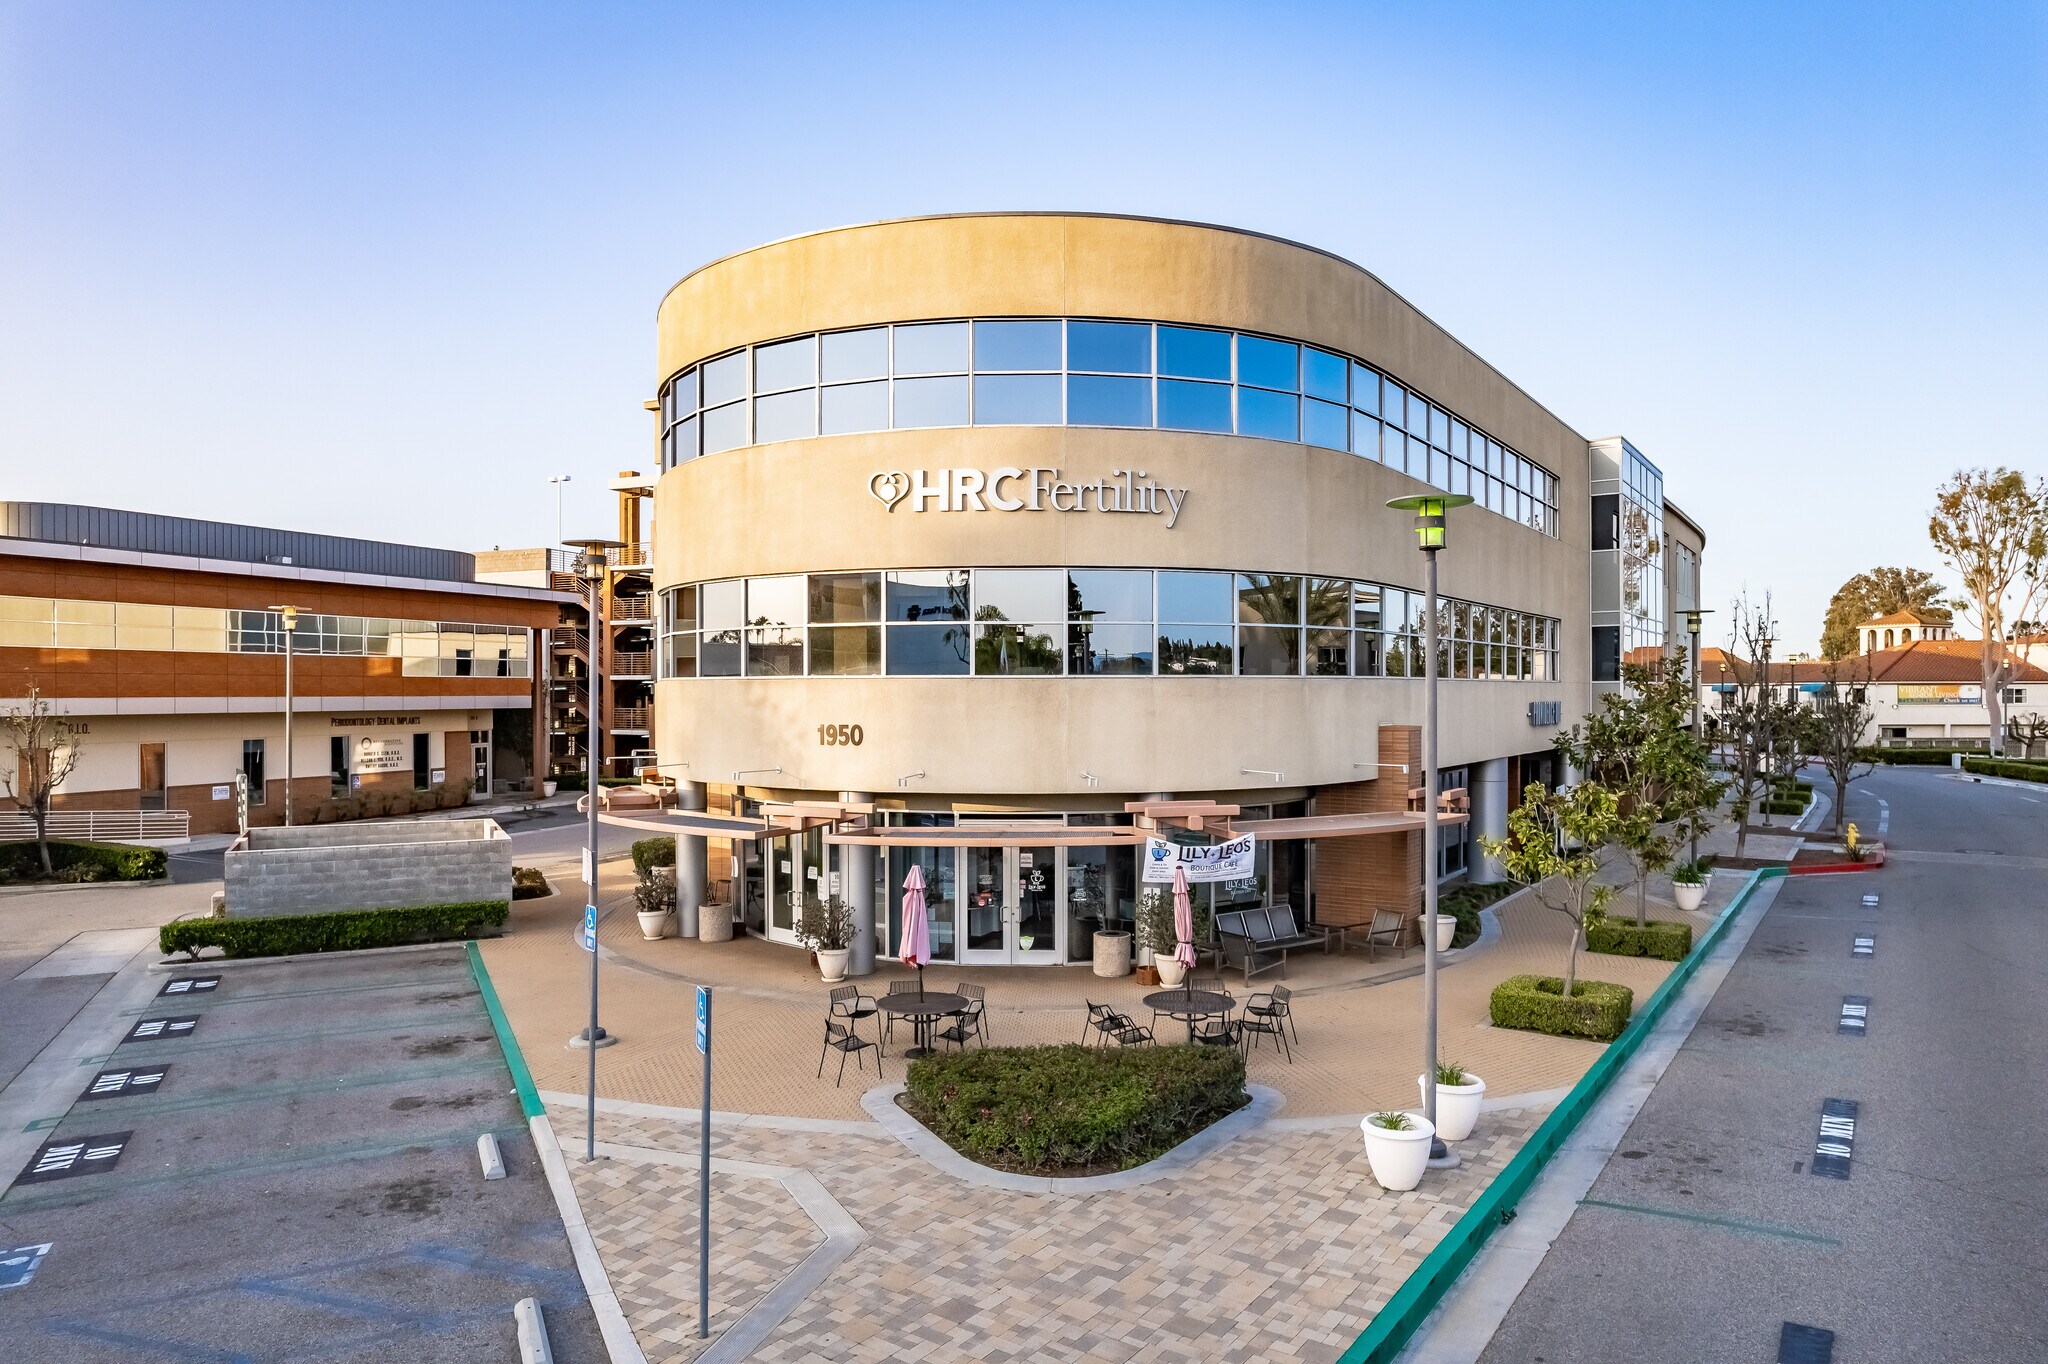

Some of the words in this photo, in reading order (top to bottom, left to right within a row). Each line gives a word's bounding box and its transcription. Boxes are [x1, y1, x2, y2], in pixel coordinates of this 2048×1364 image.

[913, 467, 1024, 512] HRC
[1025, 467, 1188, 529] Fertility
[396, 716, 420, 725] IMPLANTS
[817, 724, 863, 746] 1950
[1177, 846, 1211, 862] LILY
[1191, 863, 1222, 871] BOUTIQUE
[90, 1072, 131, 1093] MIN
[132, 1073, 163, 1084] 10
[1820, 1115, 1854, 1140] MIN
[32, 1143, 84, 1172] MIN
[84, 1144, 123, 1160] 10
[1816, 1143, 1851, 1158] 10
